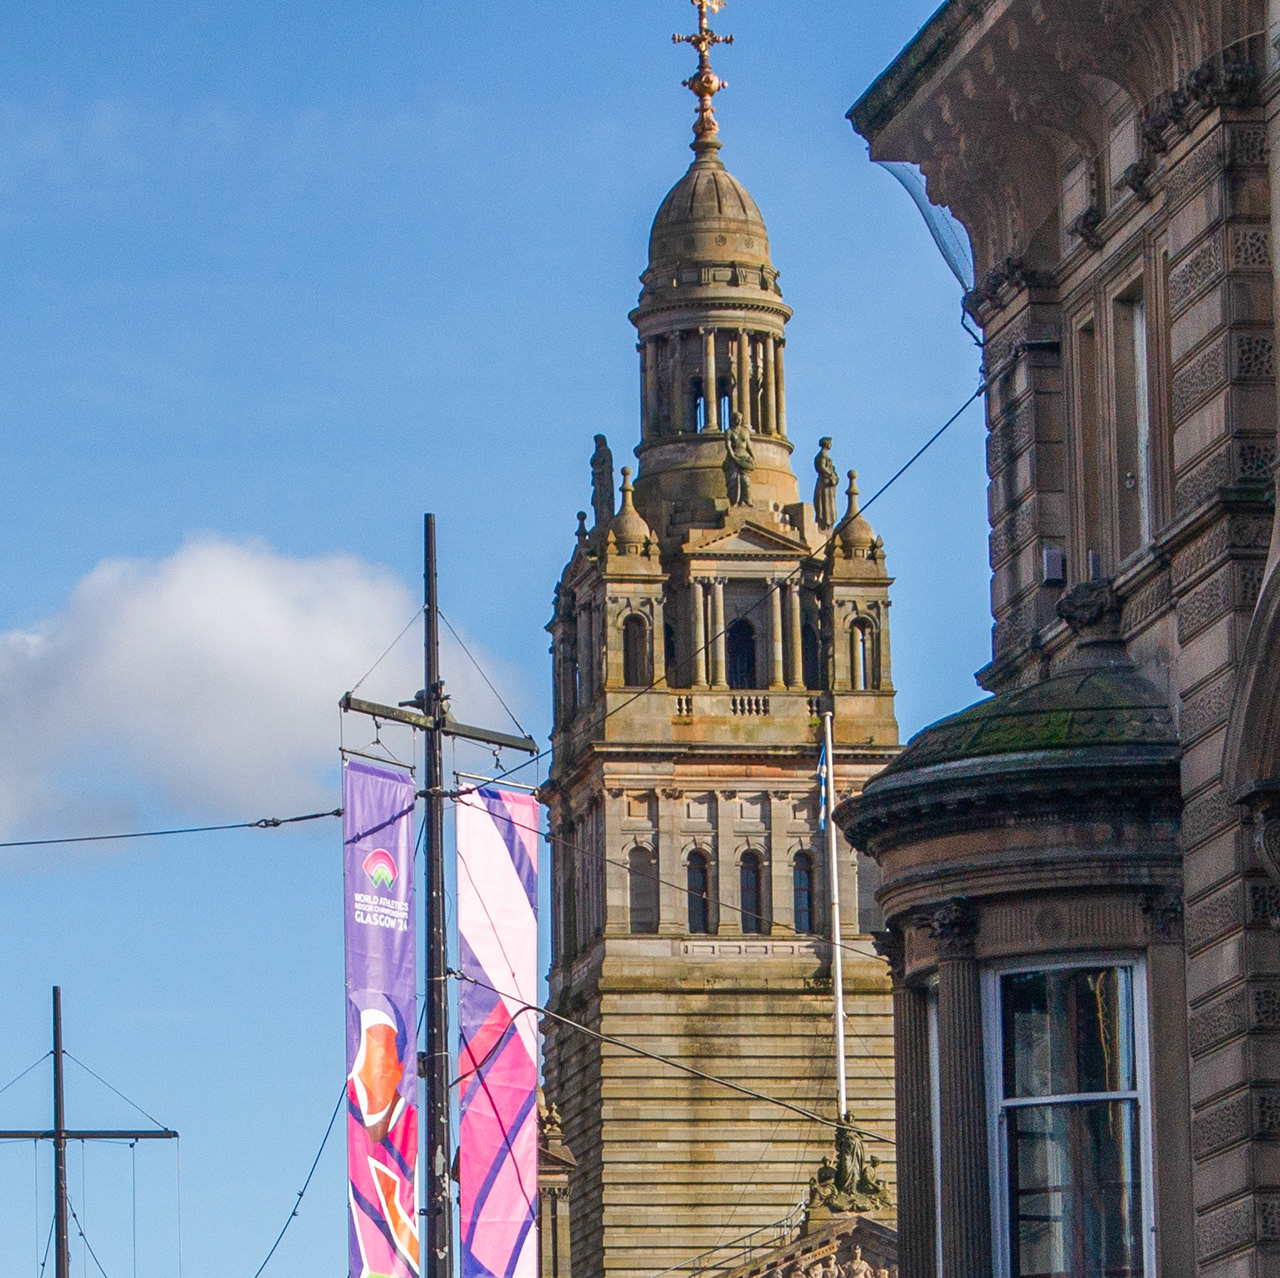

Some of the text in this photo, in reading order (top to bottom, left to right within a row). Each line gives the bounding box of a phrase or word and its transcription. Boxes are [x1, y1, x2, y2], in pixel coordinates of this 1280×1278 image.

[354, 892, 409, 911] WORLD ATHLETICS
[355, 910, 408, 931] GLASGOW 24
